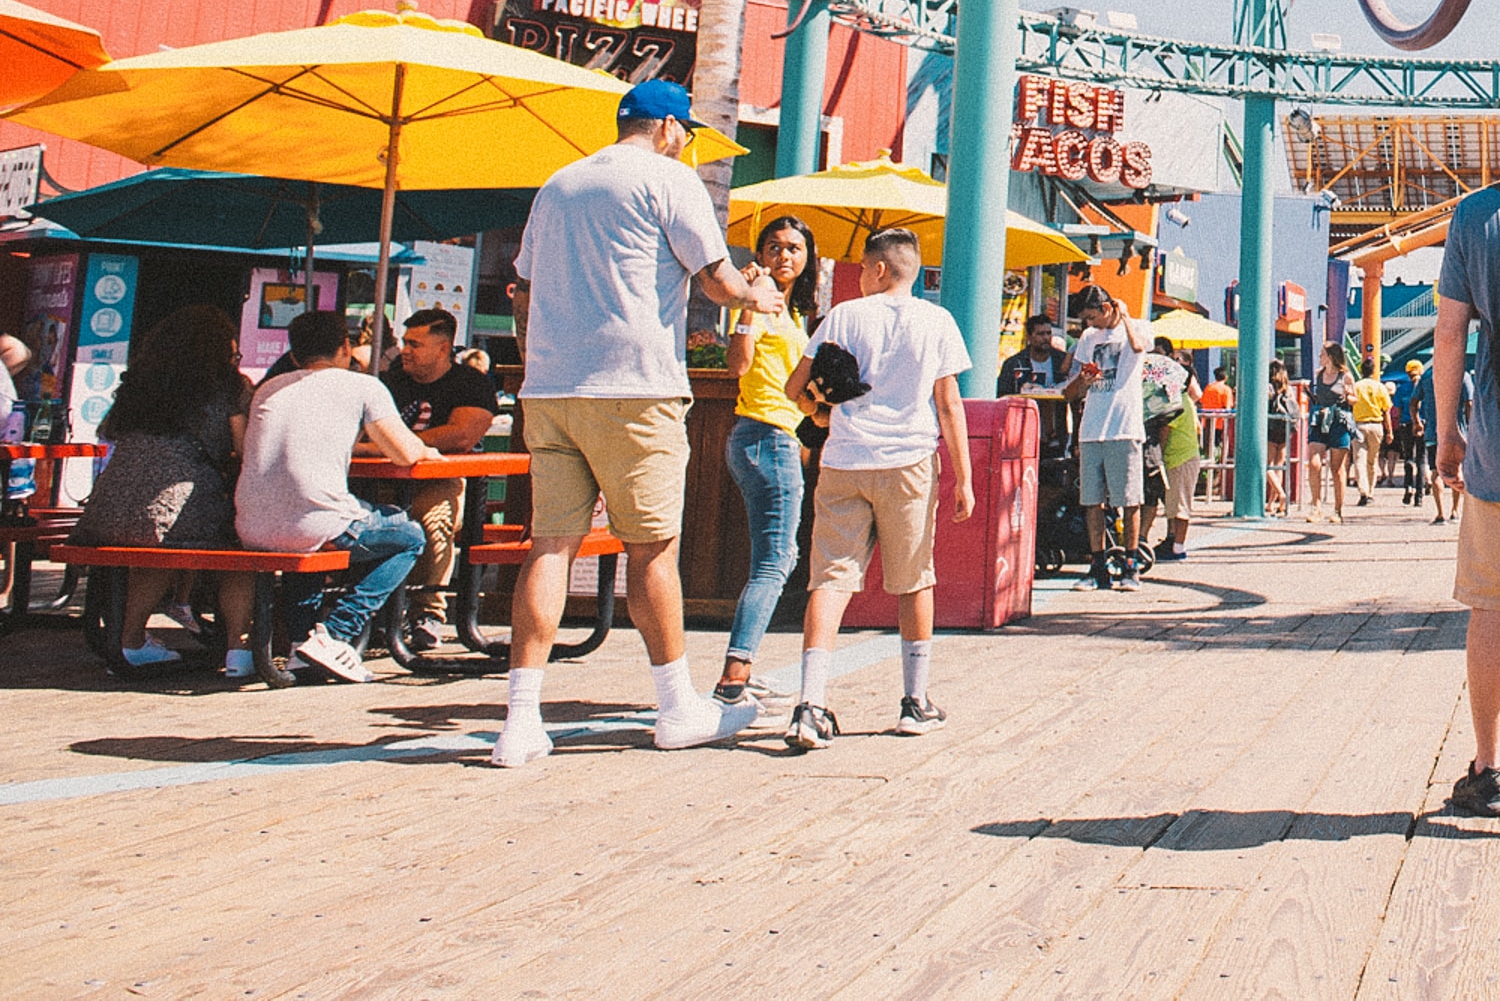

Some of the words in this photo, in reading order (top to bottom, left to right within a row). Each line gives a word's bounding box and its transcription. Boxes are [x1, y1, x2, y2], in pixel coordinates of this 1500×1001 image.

[640, 3, 699, 32] WHEE
[506, 17, 690, 82] PIZZ
[1019, 75, 1125, 133] FISH
